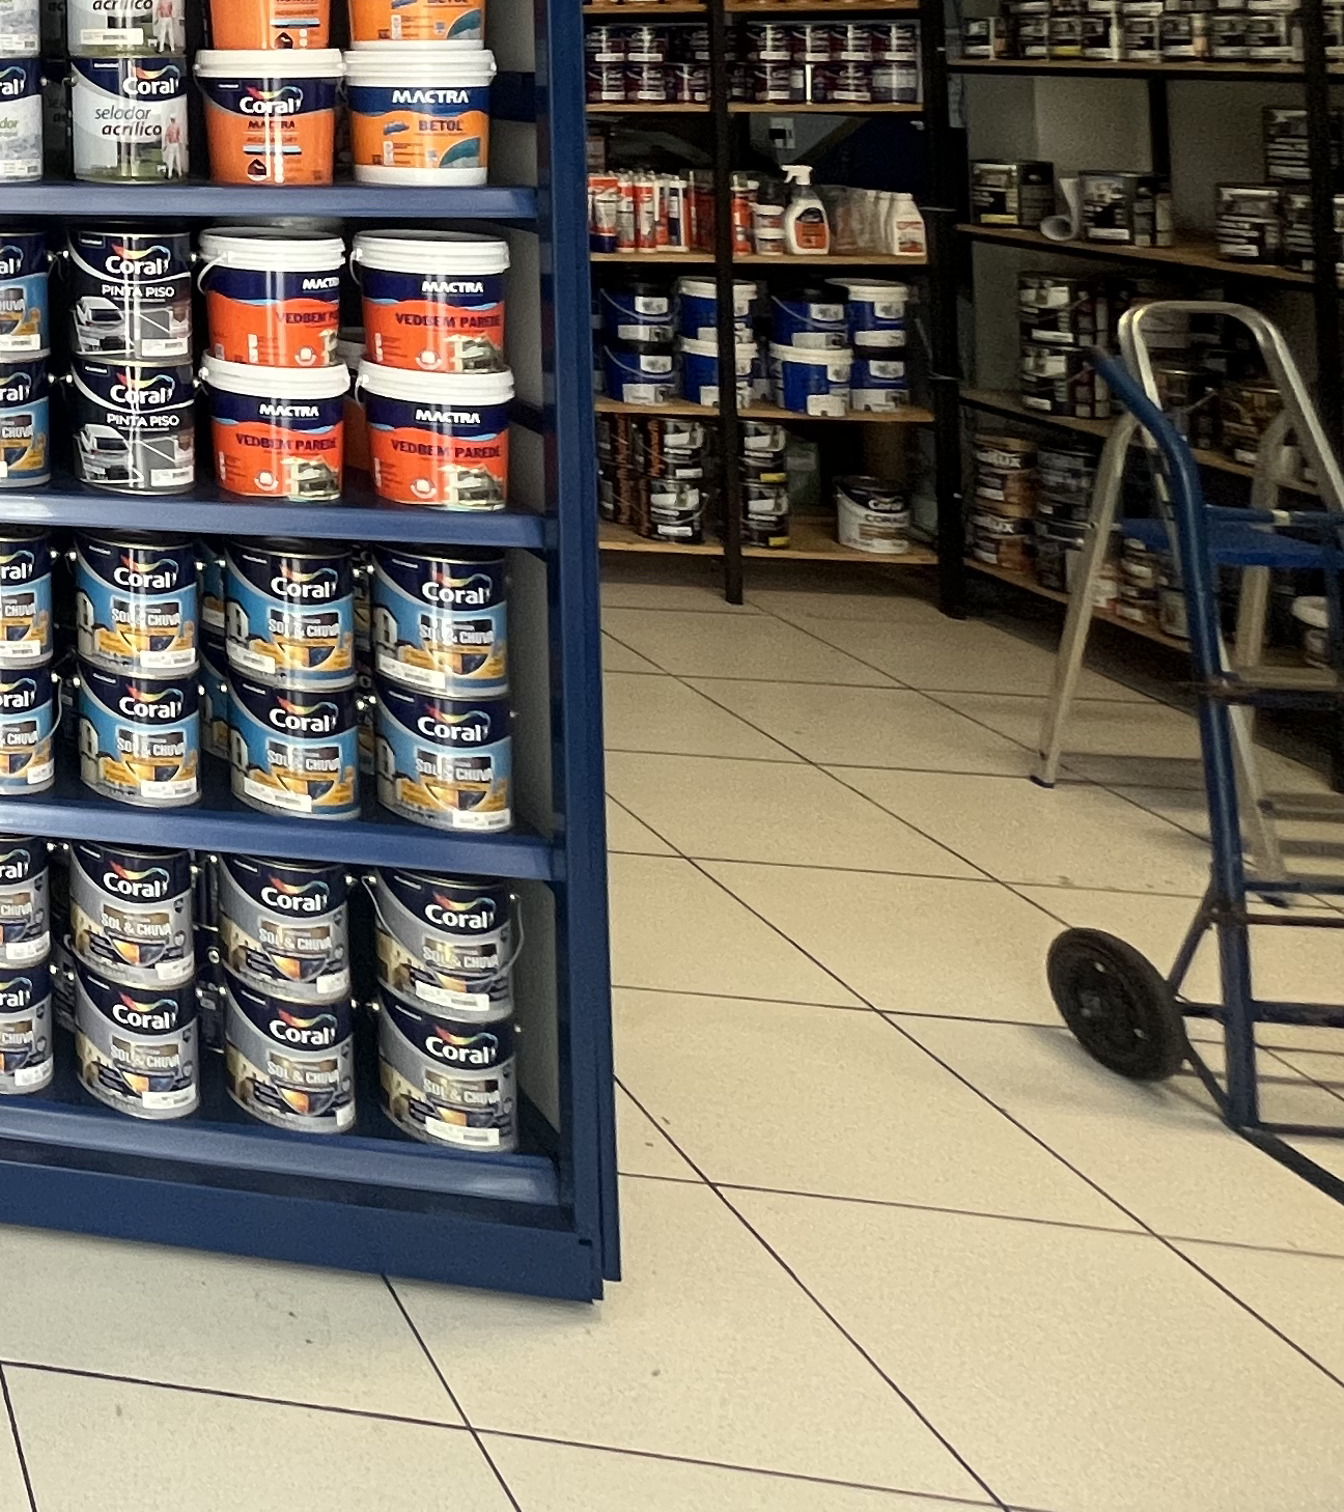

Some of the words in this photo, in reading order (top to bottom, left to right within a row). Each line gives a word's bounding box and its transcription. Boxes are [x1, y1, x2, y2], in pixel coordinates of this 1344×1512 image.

[122, 77, 173, 95] Coral
[240, 96, 295, 114] Coral
[392, 89, 469, 105] MACTRA
[94, 105, 150, 121] selador
[102, 122, 162, 137] acrílico
[105, 256, 162, 275] Coral
[102, 284, 139, 298] PINTA
[143, 285, 175, 299] PISO
[422, 280, 483, 294] MACTRA
[108, 384, 166, 403] Coral
[107, 413, 144, 427] PINTA
[147, 413, 179, 427] PISO
[259, 405, 318, 418] MACTRA
[416, 410, 481, 424] MACTRA
[271, 577, 329, 599] Coral
[422, 583, 485, 605] Coral
[270, 708, 328, 730] Coral
[418, 719, 482, 741] Coral
[104, 873, 161, 897] Coral
[262, 888, 322, 911] Coral
[425, 905, 488, 928] Coral
[113, 1004, 170, 1028] Coral
[270, 1021, 330, 1044] Coral
[425, 1037, 490, 1062] Coral
